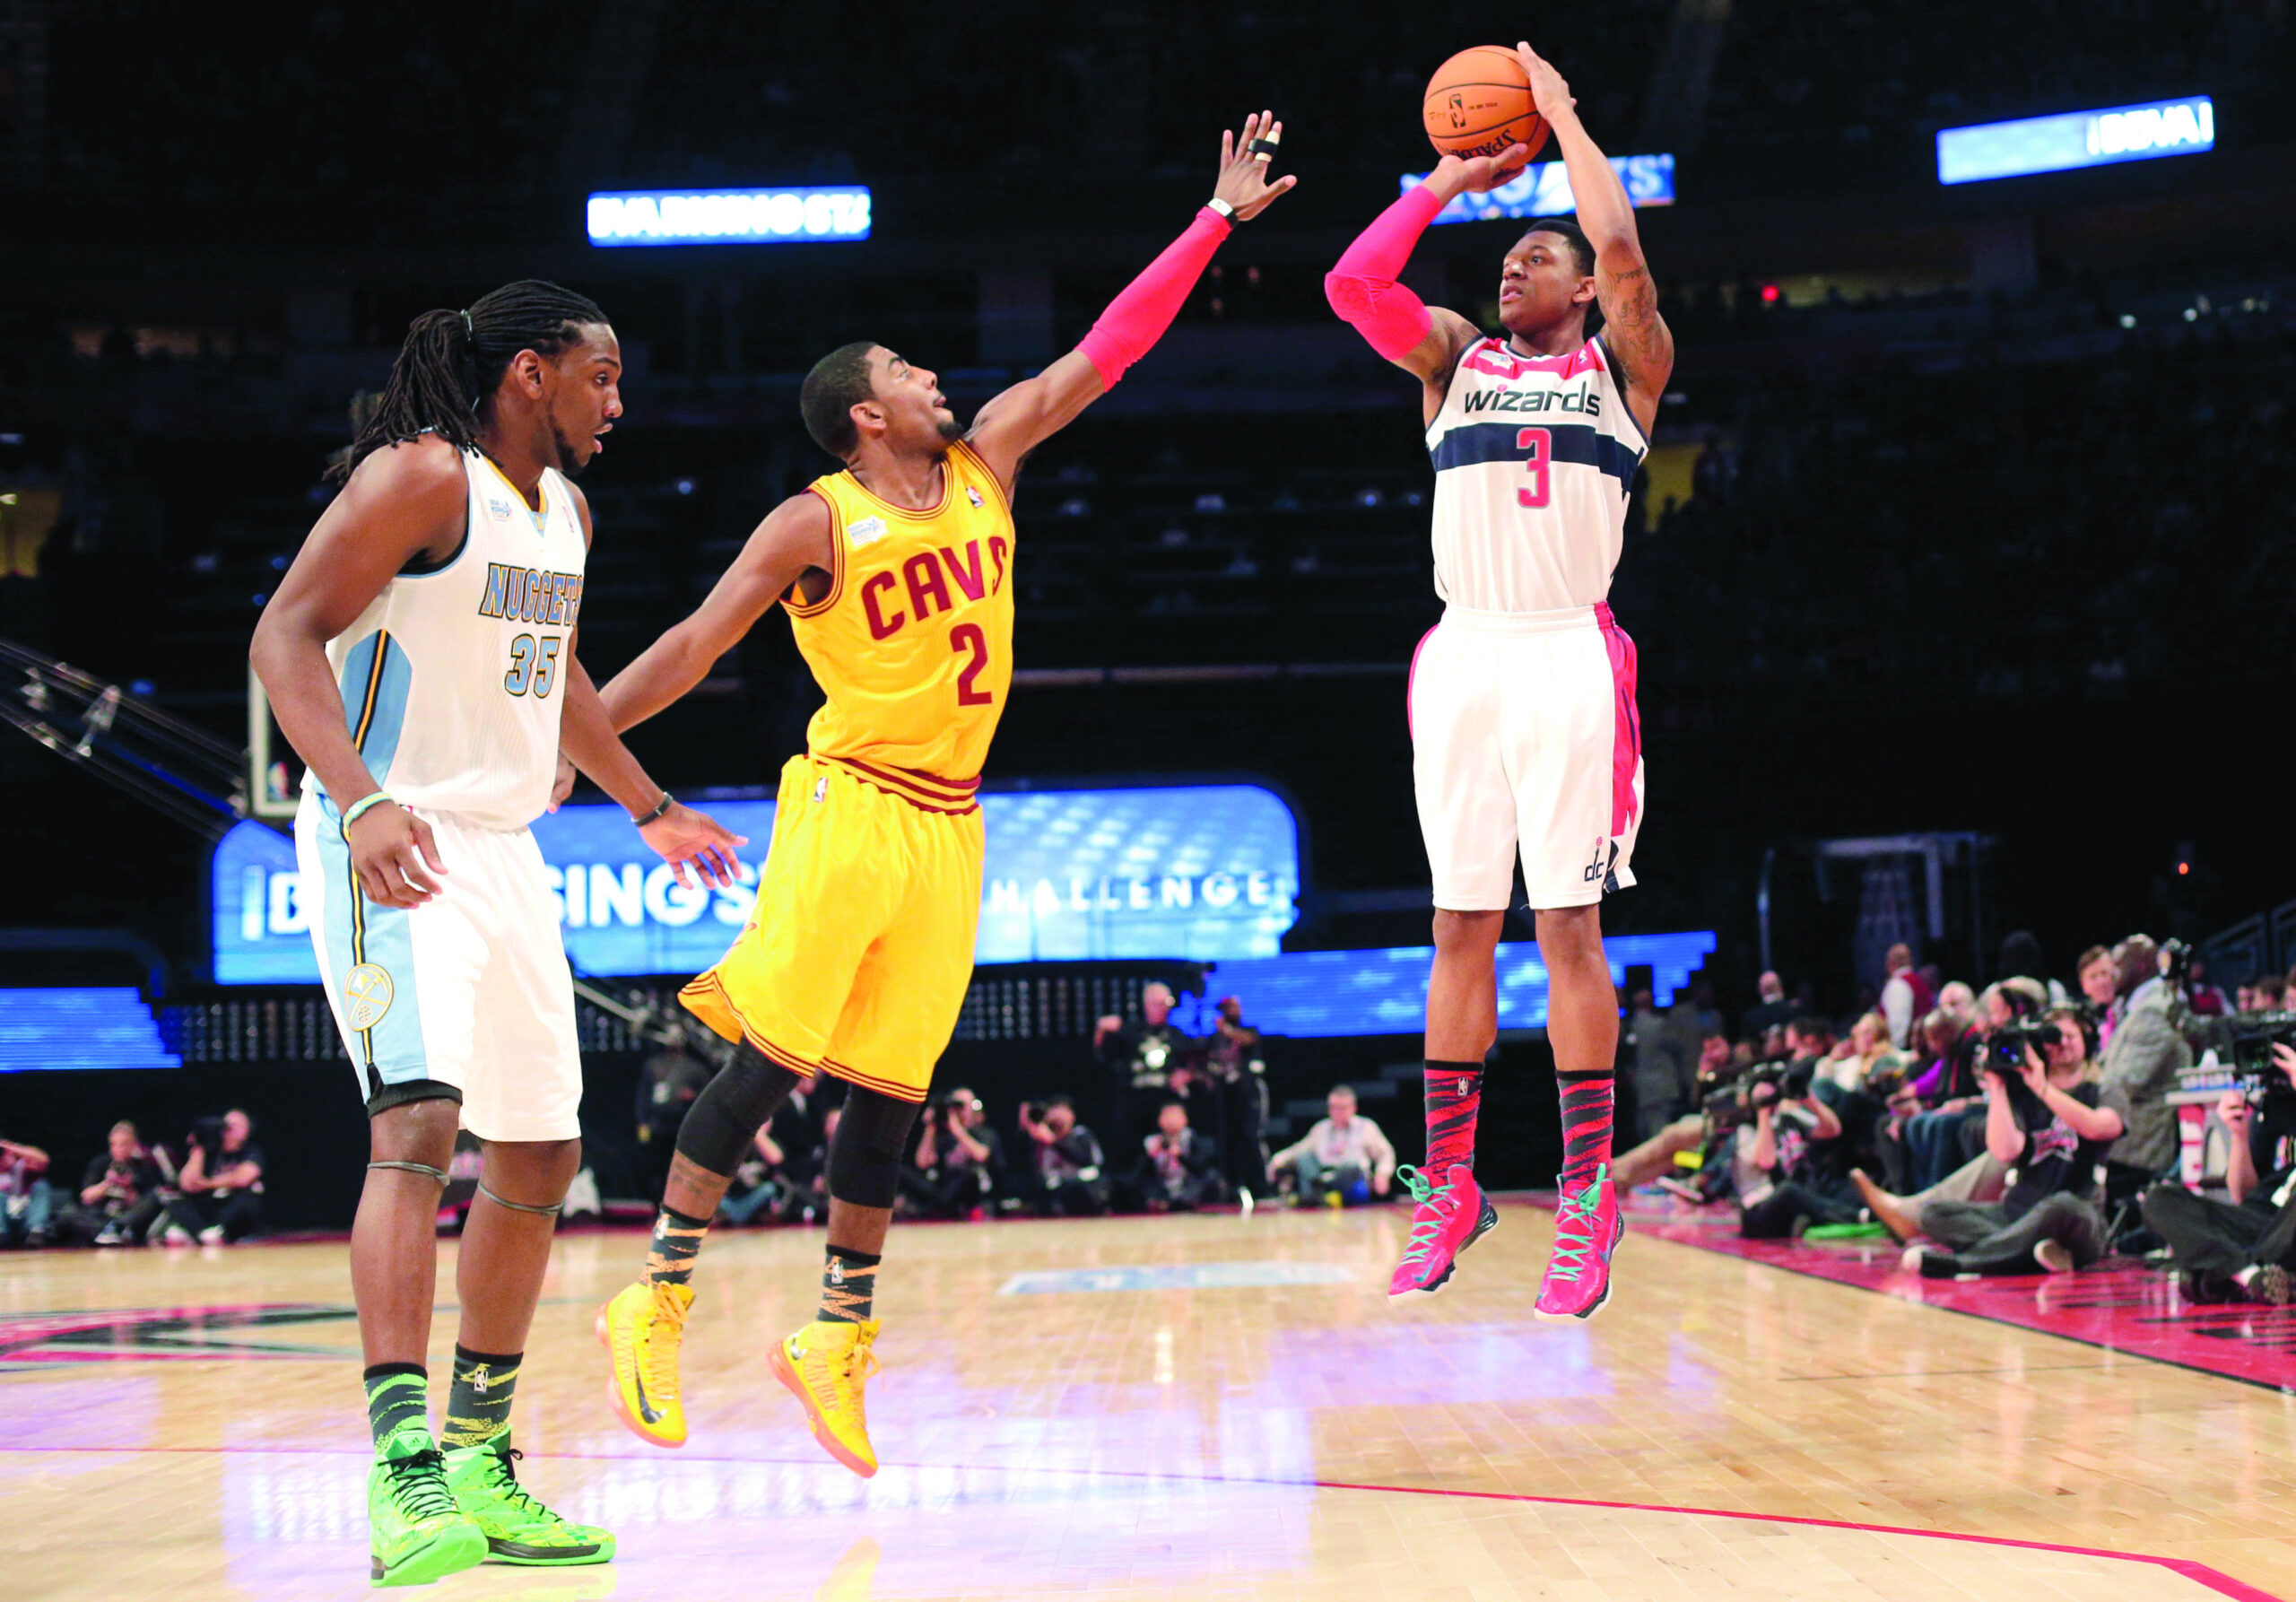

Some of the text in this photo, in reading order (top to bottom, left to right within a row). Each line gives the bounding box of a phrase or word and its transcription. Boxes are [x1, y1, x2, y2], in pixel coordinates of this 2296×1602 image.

[1465, 380, 1601, 417] wizards
[1517, 427, 1552, 509] 3
[504, 633, 561, 699] 35
[950, 623, 993, 706] 2
[989, 870, 1270, 917] HALLENGE
